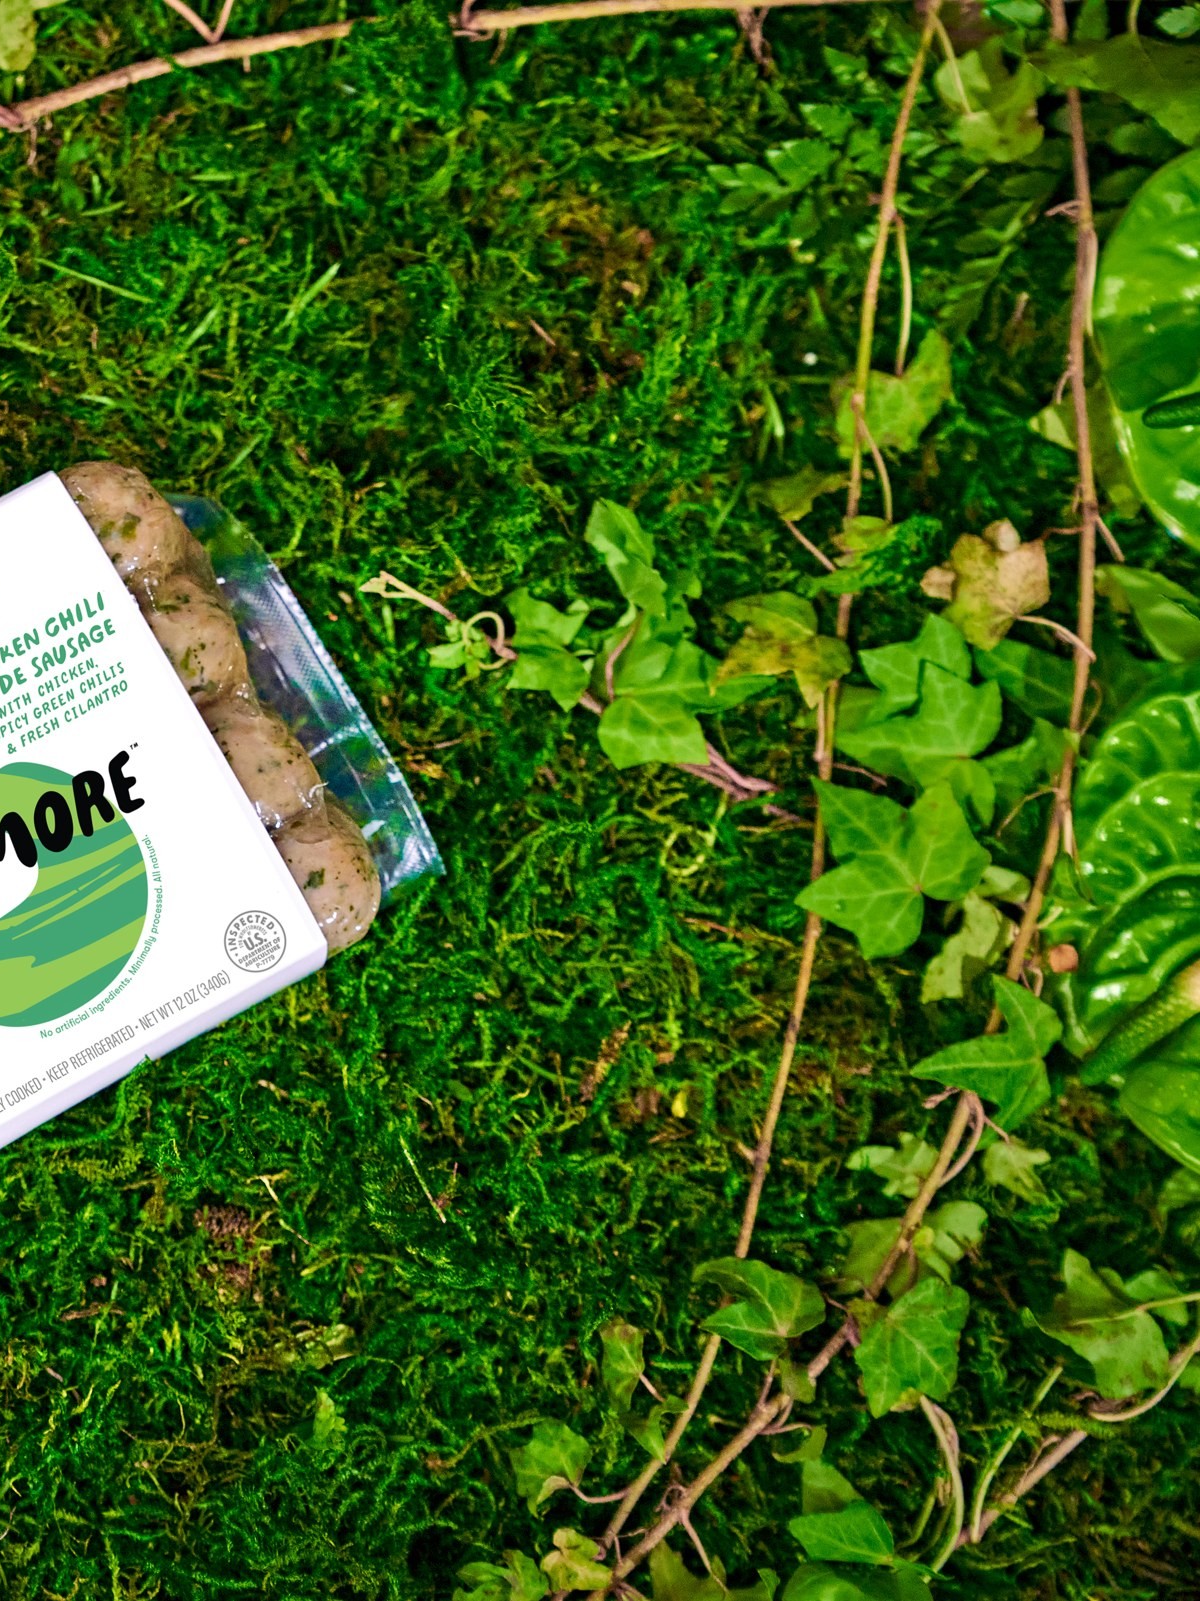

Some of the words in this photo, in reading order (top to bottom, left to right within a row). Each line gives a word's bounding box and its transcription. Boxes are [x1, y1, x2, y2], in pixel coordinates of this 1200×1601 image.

[45, 591, 105, 638] CHILI
[31, 618, 116, 677] SAUSAGE
[33, 688, 75, 720] GREEN
[80, 661, 125, 695] CHILIS
[38, 657, 99, 697] CHICKEN,
[7, 743, 17, 754] &
[20, 717, 60, 747] FRESH
[64, 680, 129, 723] CILANTRO
[142, 834, 158, 870] natural.
[152, 870, 162, 882] All
[152, 885, 163, 935] processed.
[228, 914, 275, 951] INSPECTED
[238, 941, 273, 964] DEPARTMENT
[272, 936, 281, 945] OF
[243, 932, 267, 951] U.S.
[128, 936, 157, 976] Minimally
[245, 943, 281, 968] AGRICULTURE
[89, 977, 132, 1015] ingredients.
[5, 1077, 43, 1107] COOKED
[46, 1060, 69, 1083] KEEP
[69, 1025, 135, 1070] REFRIGERATED
[139, 1011, 159, 1031] NET
[156, 1002, 174, 1020] WT
[172, 997, 186, 1011] 12
[184, 989, 200, 1005] OZ
[197, 970, 231, 999] (340G)
[40, 1029, 53, 1039] No
[55, 1010, 89, 1034] artificial
